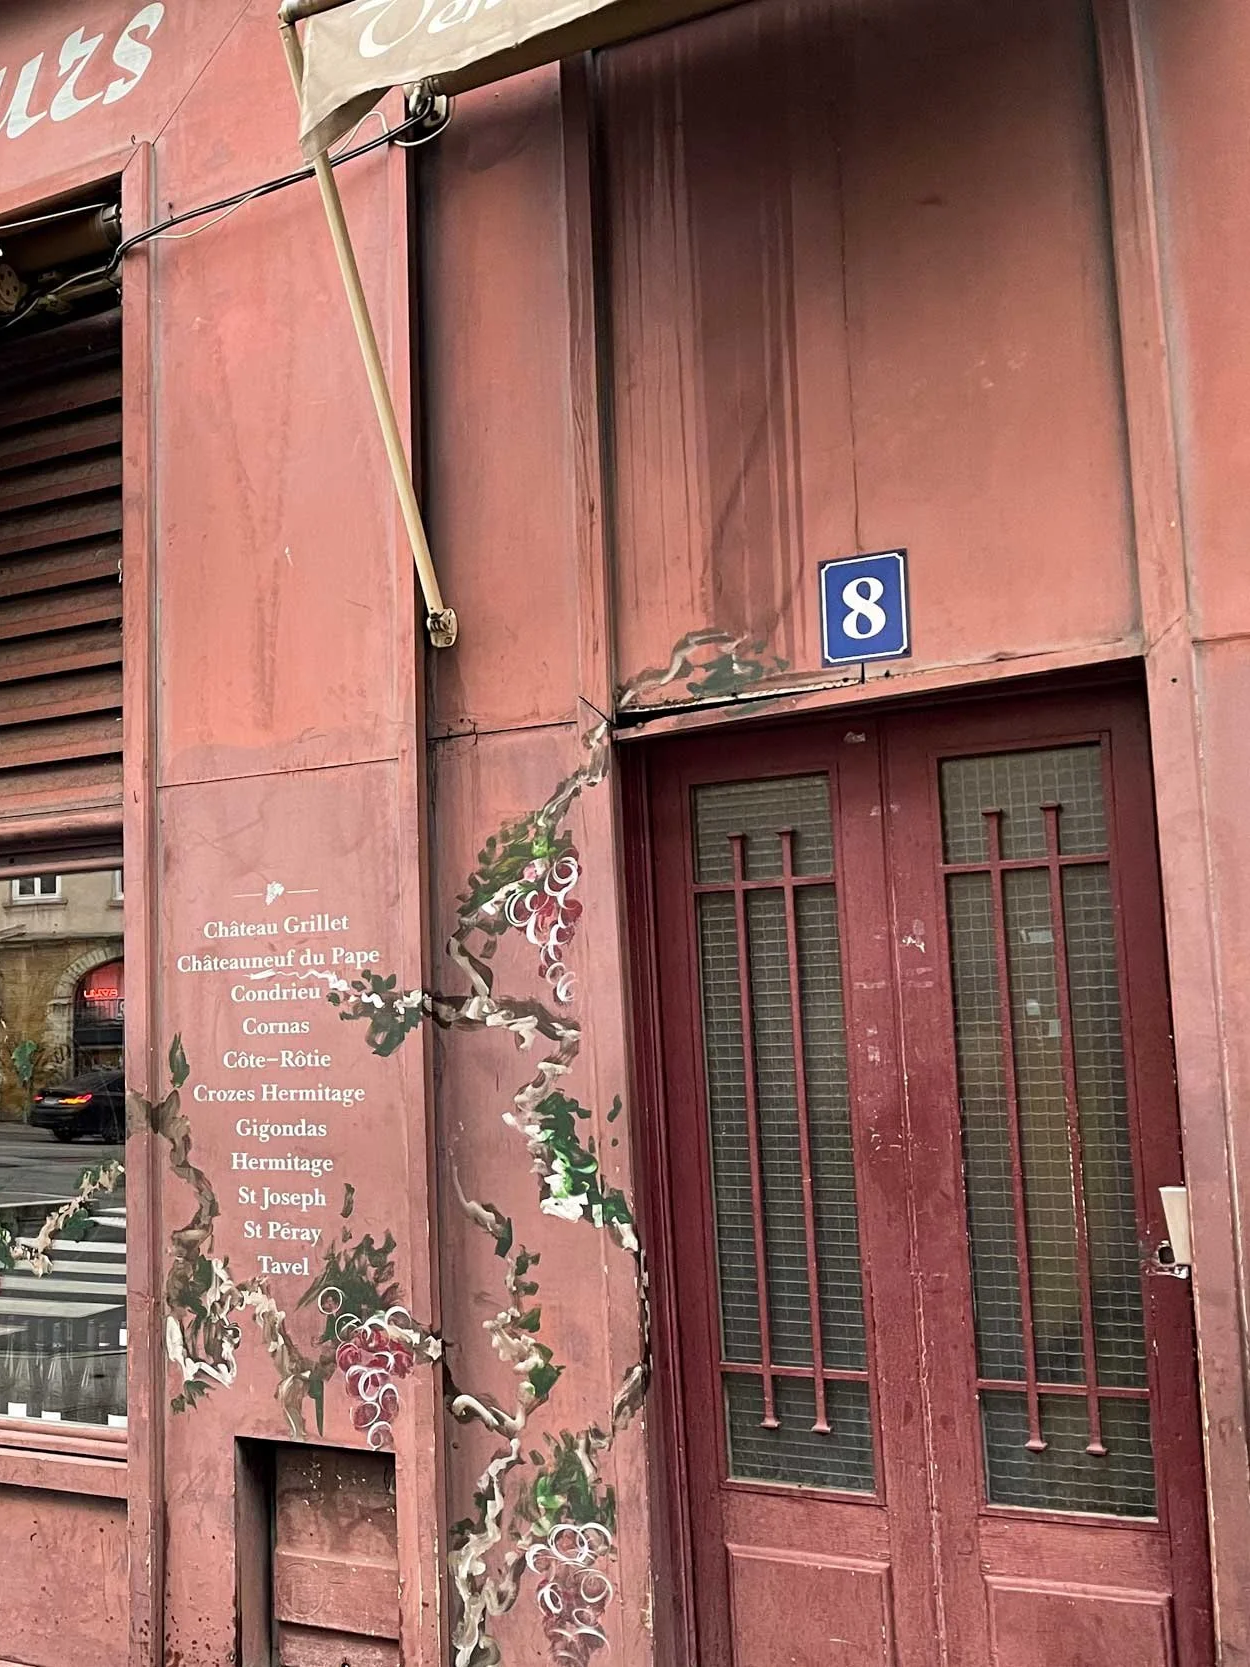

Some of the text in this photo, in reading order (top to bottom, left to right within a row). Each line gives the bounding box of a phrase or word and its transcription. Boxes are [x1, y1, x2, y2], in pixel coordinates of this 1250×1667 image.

[842, 577, 886, 639] 8
[203, 913, 349, 939] Château Grillet
[177, 947, 380, 972] Châteauneuf du Pape
[230, 983, 321, 1002] Condrieu
[242, 1017, 310, 1035] Cornas
[223, 1049, 331, 1069] Côte-Rôtie
[193, 1084, 365, 1107] Crozes Hermitage
[235, 1118, 327, 1142] Gigondas
[231, 1152, 334, 1177] Hermitage
[238, 1186, 326, 1212] St Joseph
[244, 1220, 322, 1247] St Péray
[257, 1256, 310, 1275] Tavel
